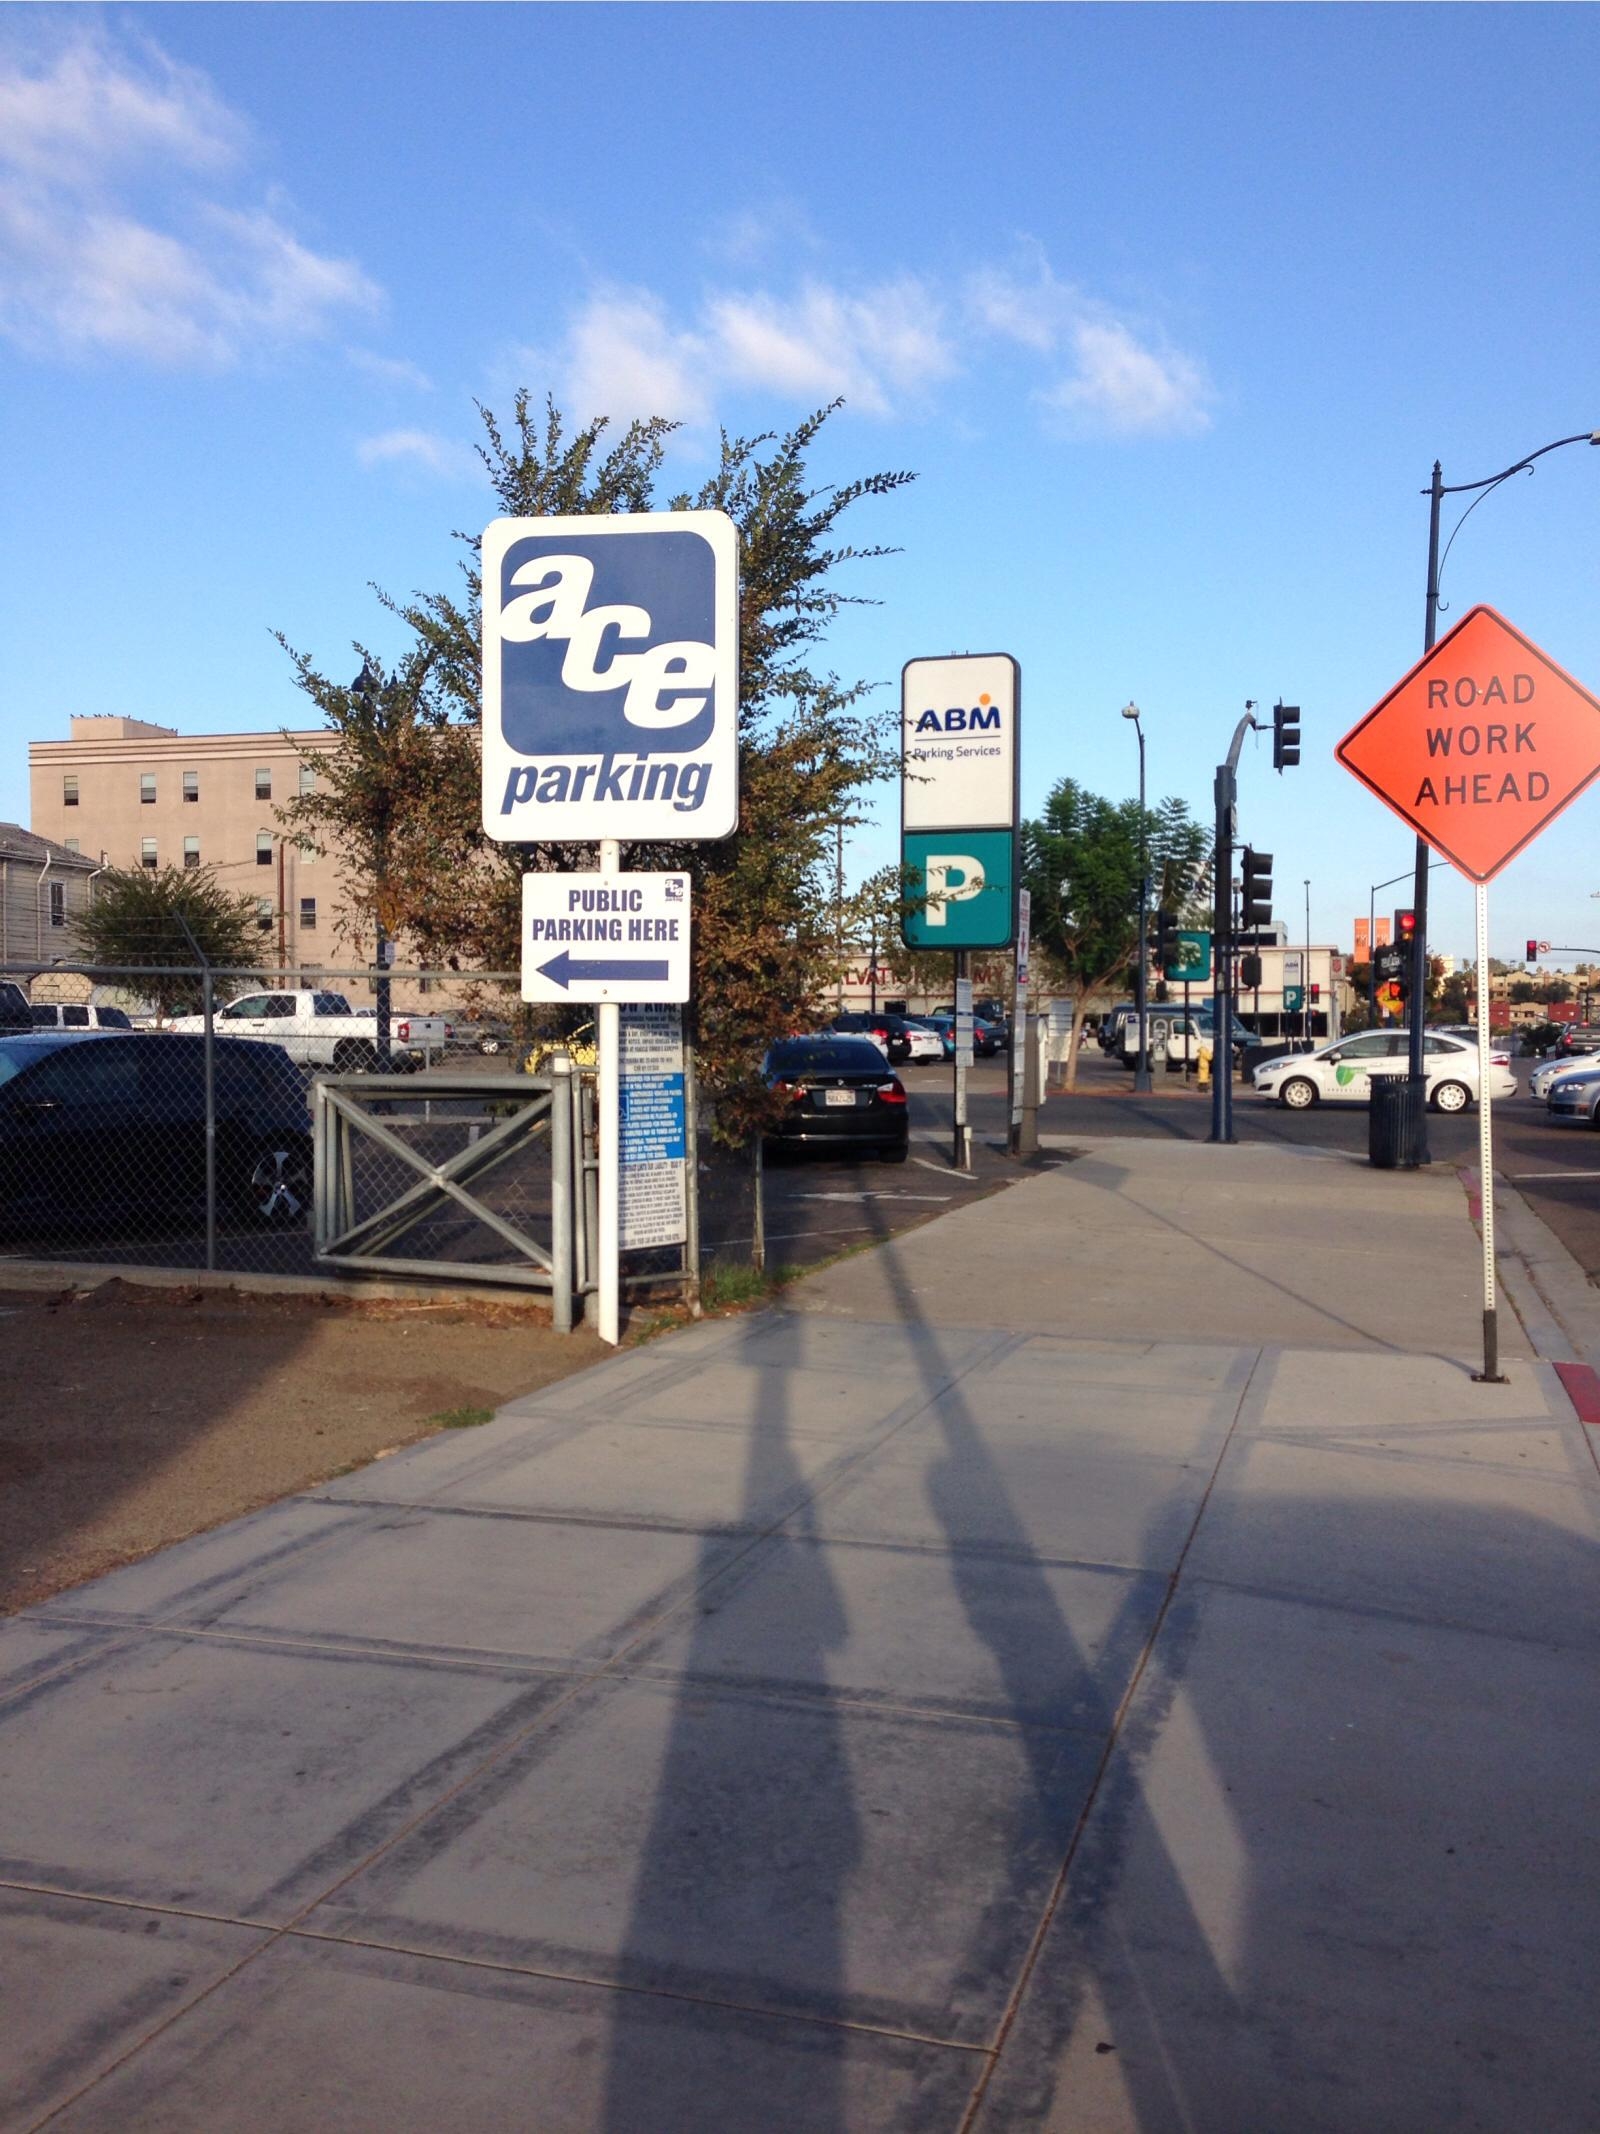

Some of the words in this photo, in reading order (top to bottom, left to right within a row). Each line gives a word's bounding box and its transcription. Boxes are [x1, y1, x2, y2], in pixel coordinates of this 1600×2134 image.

[501, 554, 716, 729] ace
[1428, 674, 1535, 709] ROAD
[915, 706, 1001, 733] ABM
[914, 748, 954, 761] Parking
[956, 745, 1001, 758] Services
[1426, 722, 1537, 758] WORK
[500, 752, 713, 815] parking
[1414, 771, 1550, 806] AHEAD
[568, 889, 643, 913] PUBLIC
[925, 854, 986, 927] P
[532, 918, 622, 941] PARKING
[628, 918, 679, 941] HERE
[1286, 990, 1297, 1006] P
